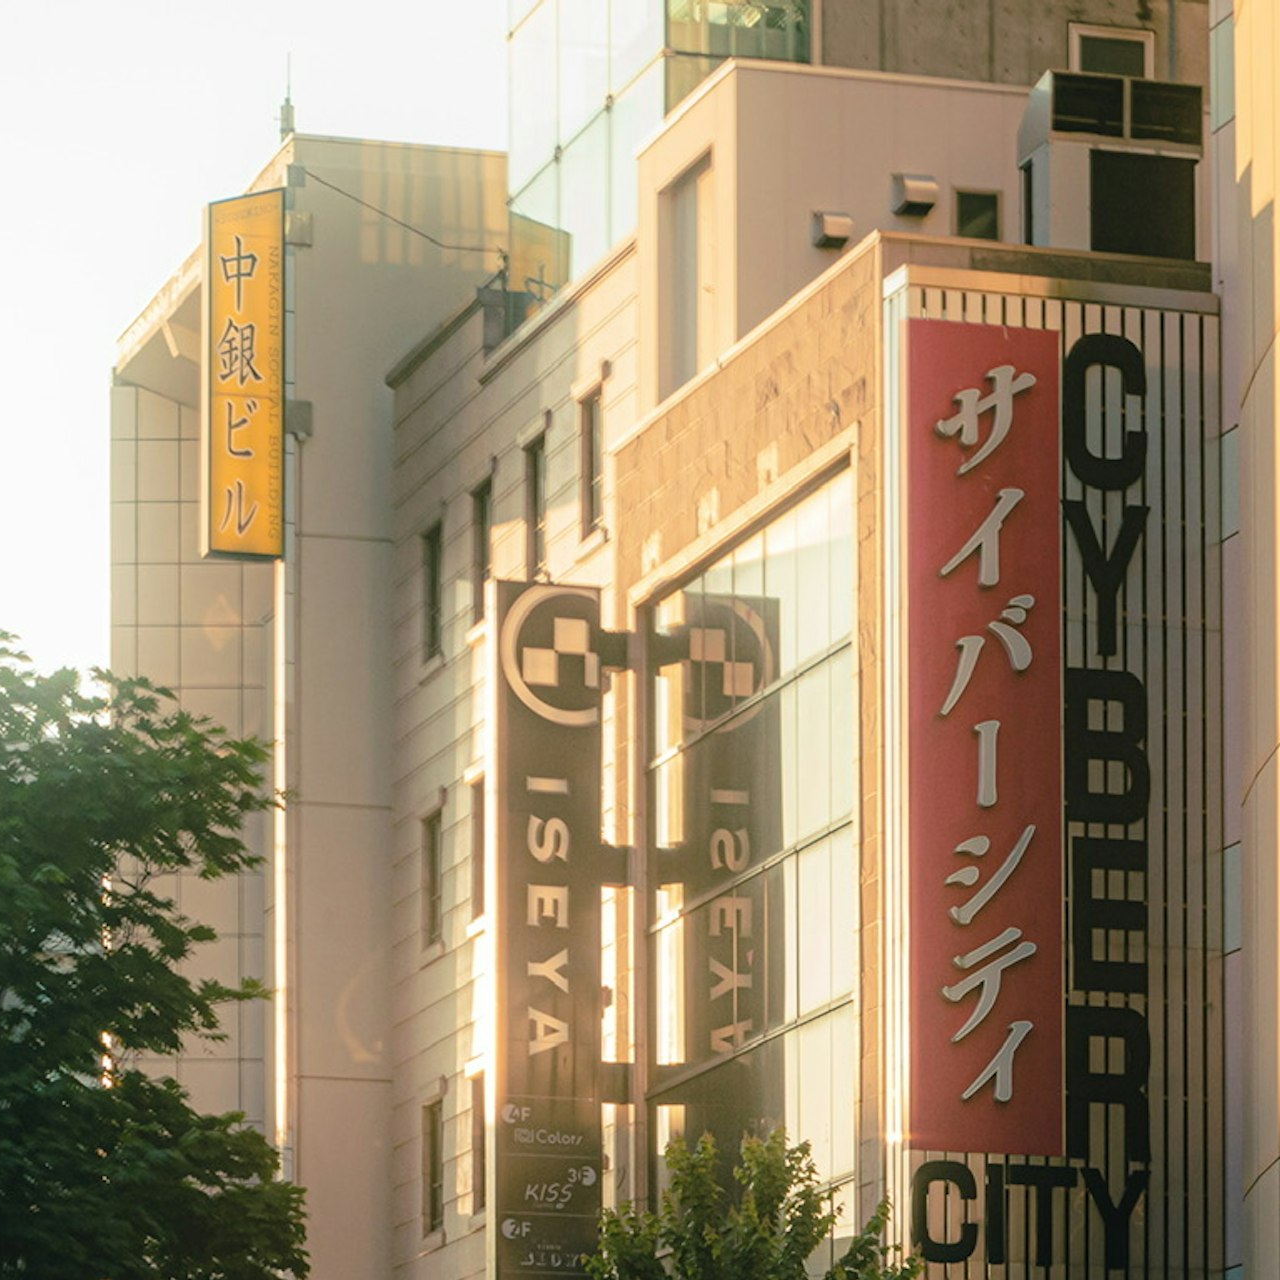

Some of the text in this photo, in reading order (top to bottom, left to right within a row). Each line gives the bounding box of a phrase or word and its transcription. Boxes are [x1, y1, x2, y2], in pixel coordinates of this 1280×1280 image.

[218, 234, 262, 534] 中銀ビル
[267, 244, 279, 336] NAKAGIN
[935, 364, 1037, 1101] サイバーシティ
[1060, 333, 1151, 1162] CYBER
[526, 775, 570, 1055] ISEYA
[524, 1182, 574, 1203] KISS
[912, 1160, 1151, 1270] CITY
